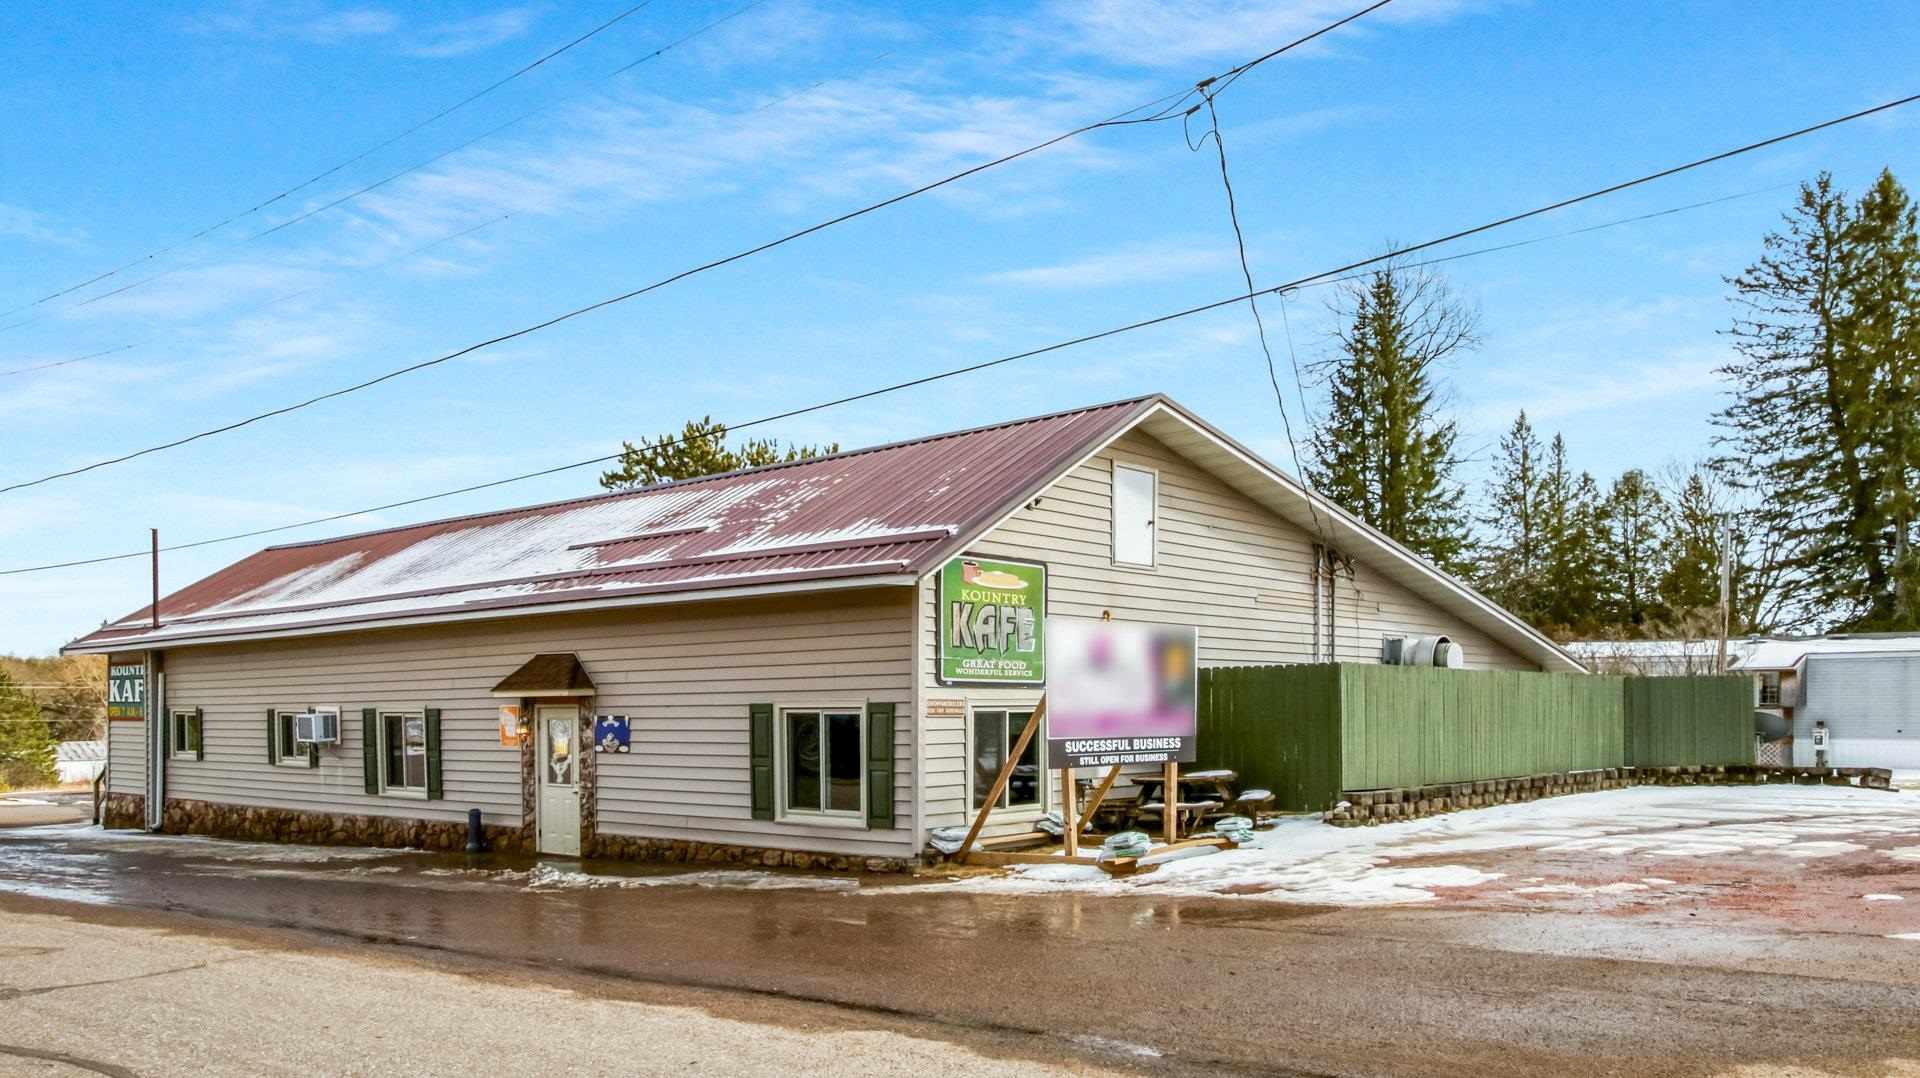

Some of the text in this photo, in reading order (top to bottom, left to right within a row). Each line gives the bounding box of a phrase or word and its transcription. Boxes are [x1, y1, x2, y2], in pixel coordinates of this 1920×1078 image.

[961, 589, 1027, 605] KOUNTRY
[951, 600, 1036, 657] KAFE
[962, 659, 1027, 670] GREAT FOOD
[955, 667, 1033, 677] WONDERFUL SERVICE
[1065, 737, 1181, 753] SUCCESSFUL BUSINESS
[1080, 753, 1168, 766] STILL OPEN FOR BUSINESS
